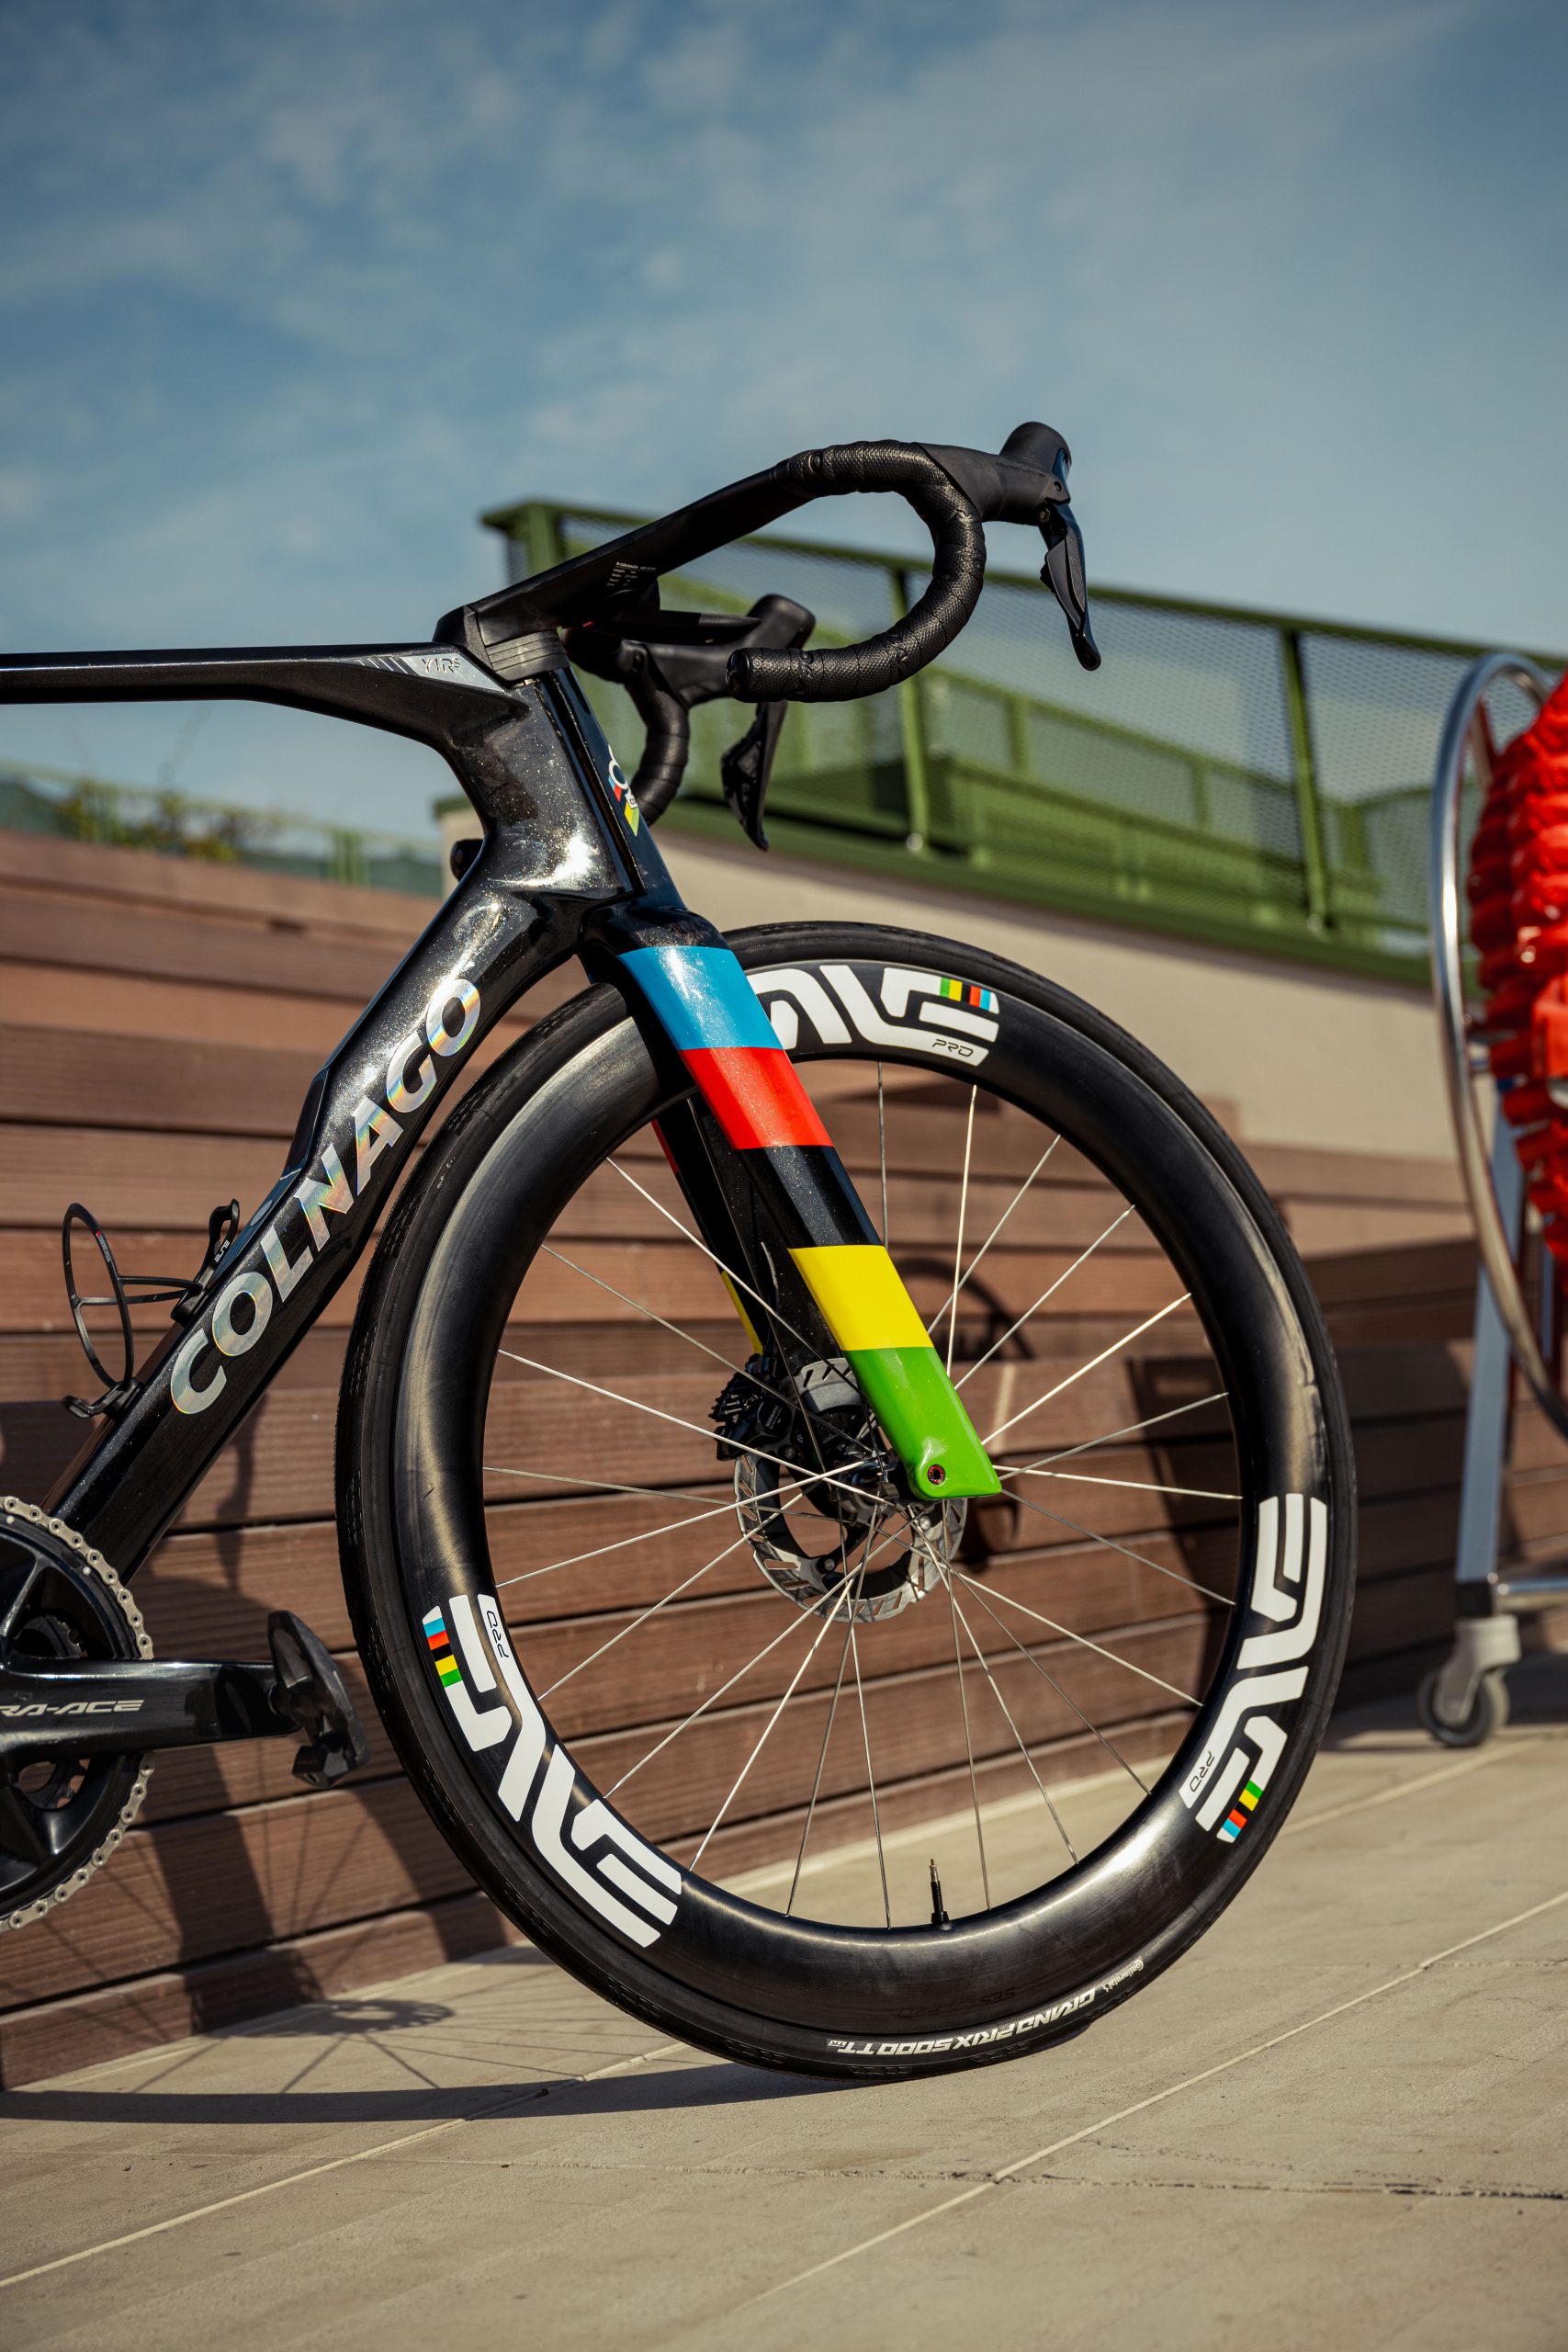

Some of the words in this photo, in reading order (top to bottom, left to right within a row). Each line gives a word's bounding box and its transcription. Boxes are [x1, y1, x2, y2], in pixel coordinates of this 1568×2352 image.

[745, 965, 1000, 1067] NVE
[931, 1038, 974, 1057] PRO
[170, 978, 481, 1415] COLNAGO
[486, 1610, 510, 1659] PRO
[1178, 1492, 1328, 1844] ENVE
[422, 1593, 682, 1948] ENVE
[1189, 1749, 1215, 1792] PRO
[1016, 1987, 1097, 2034] GRAND
[837, 2041, 874, 2055] TT
[875, 2037, 953, 2055] 5000
[953, 2021, 1016, 2050] PRIX
